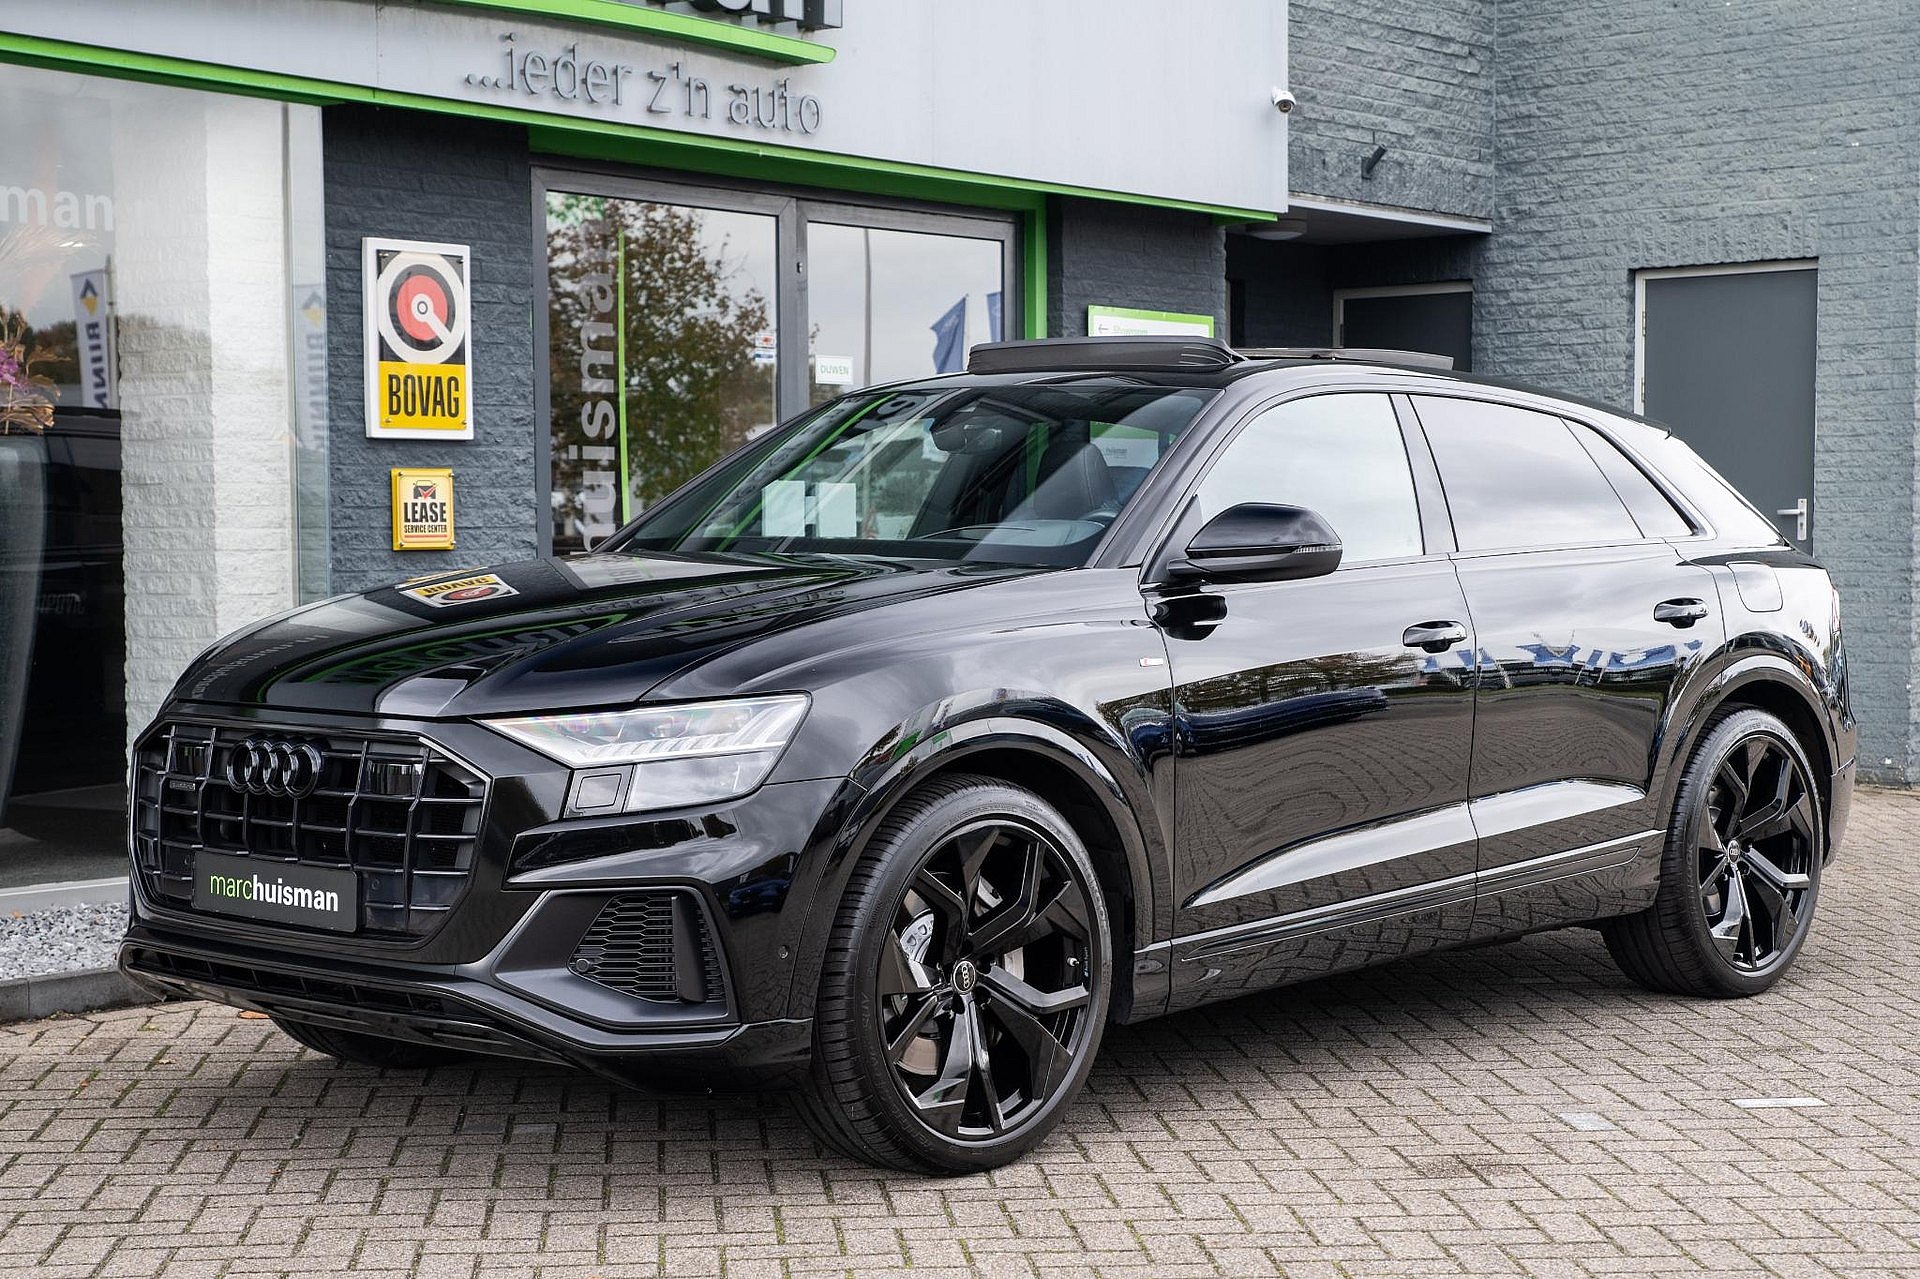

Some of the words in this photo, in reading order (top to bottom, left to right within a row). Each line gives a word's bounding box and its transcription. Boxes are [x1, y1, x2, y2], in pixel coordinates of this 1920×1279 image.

[646, 61, 712, 119] z'n
[728, 77, 823, 135] auto
[0, 186, 113, 231] man
[388, 373, 460, 418] BOVAG
[403, 502, 447, 523] LEASE
[403, 524, 427, 533] SERVICE
[427, 524, 448, 533] CENTER
[210, 874, 339, 912] marchuisman
